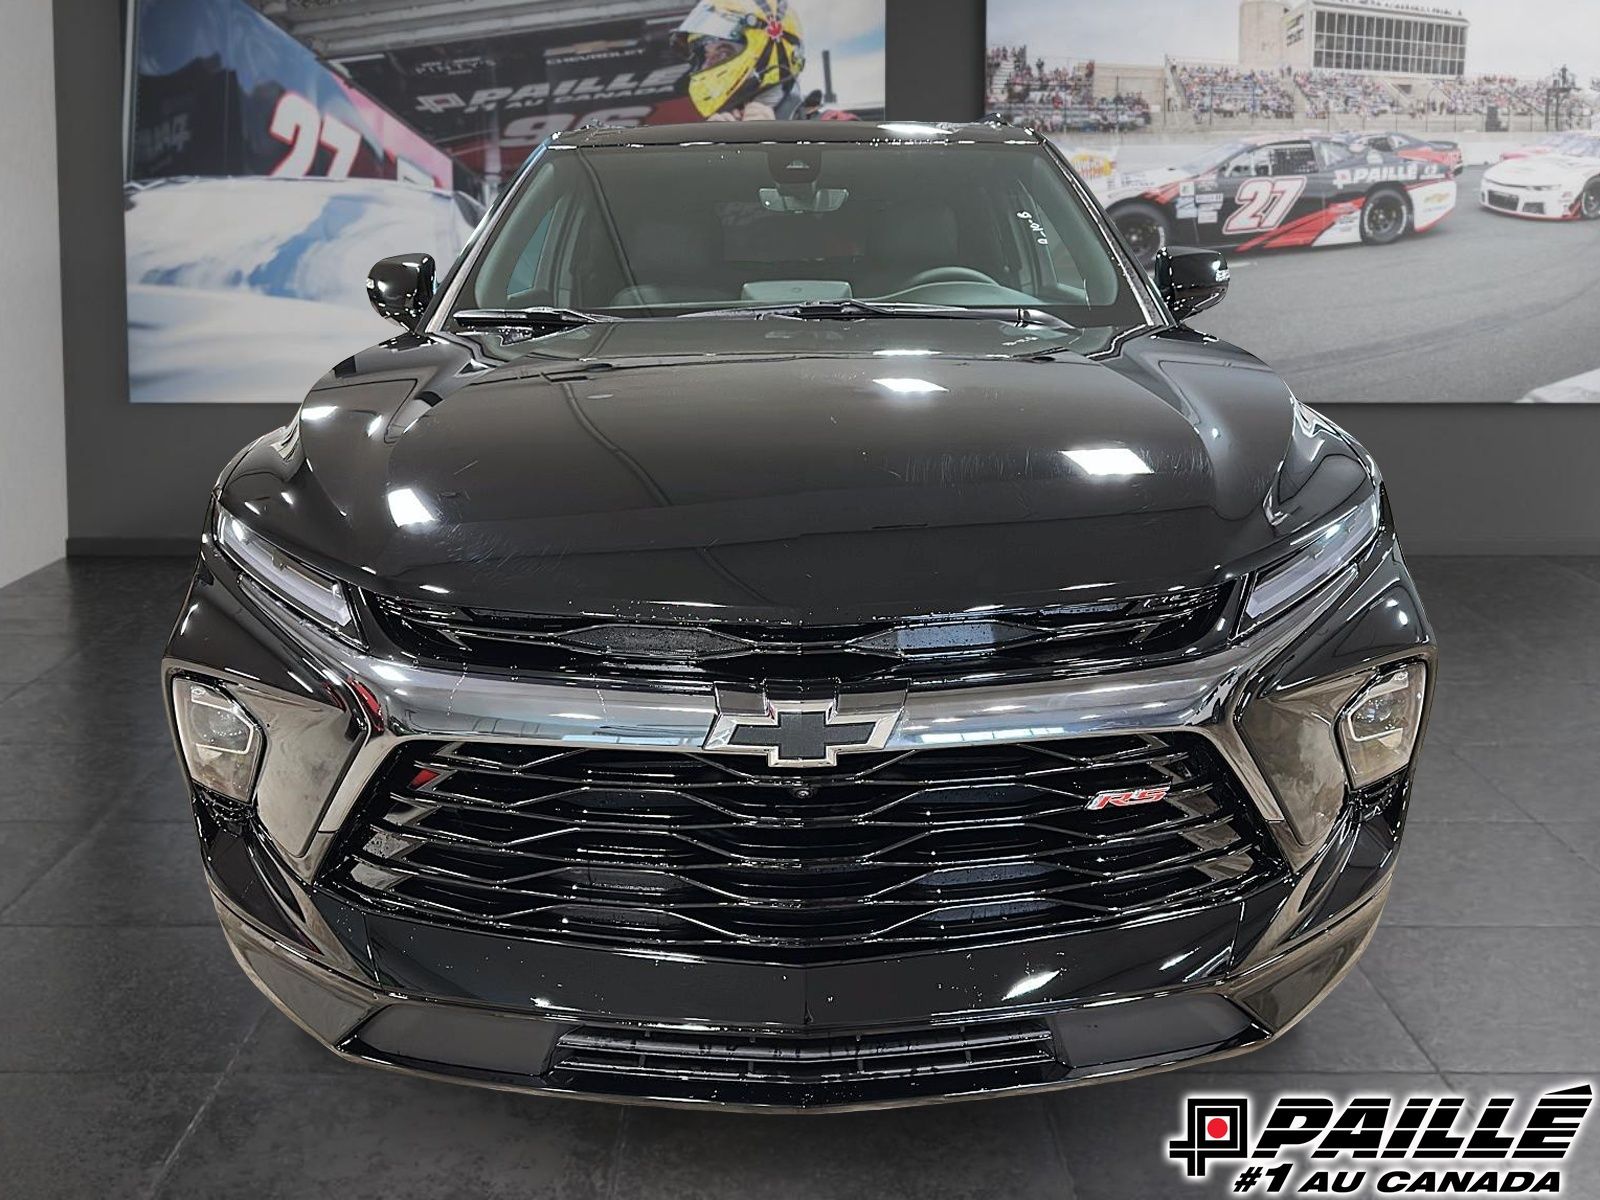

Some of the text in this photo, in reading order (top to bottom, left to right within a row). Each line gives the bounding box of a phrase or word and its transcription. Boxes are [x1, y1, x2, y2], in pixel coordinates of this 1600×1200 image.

[545, 48, 645, 66] CHEVROLET
[554, 86, 674, 103] CANADA
[268, 91, 362, 178] 27
[1223, 174, 1307, 234] 27
[1086, 786, 1168, 810] RS
